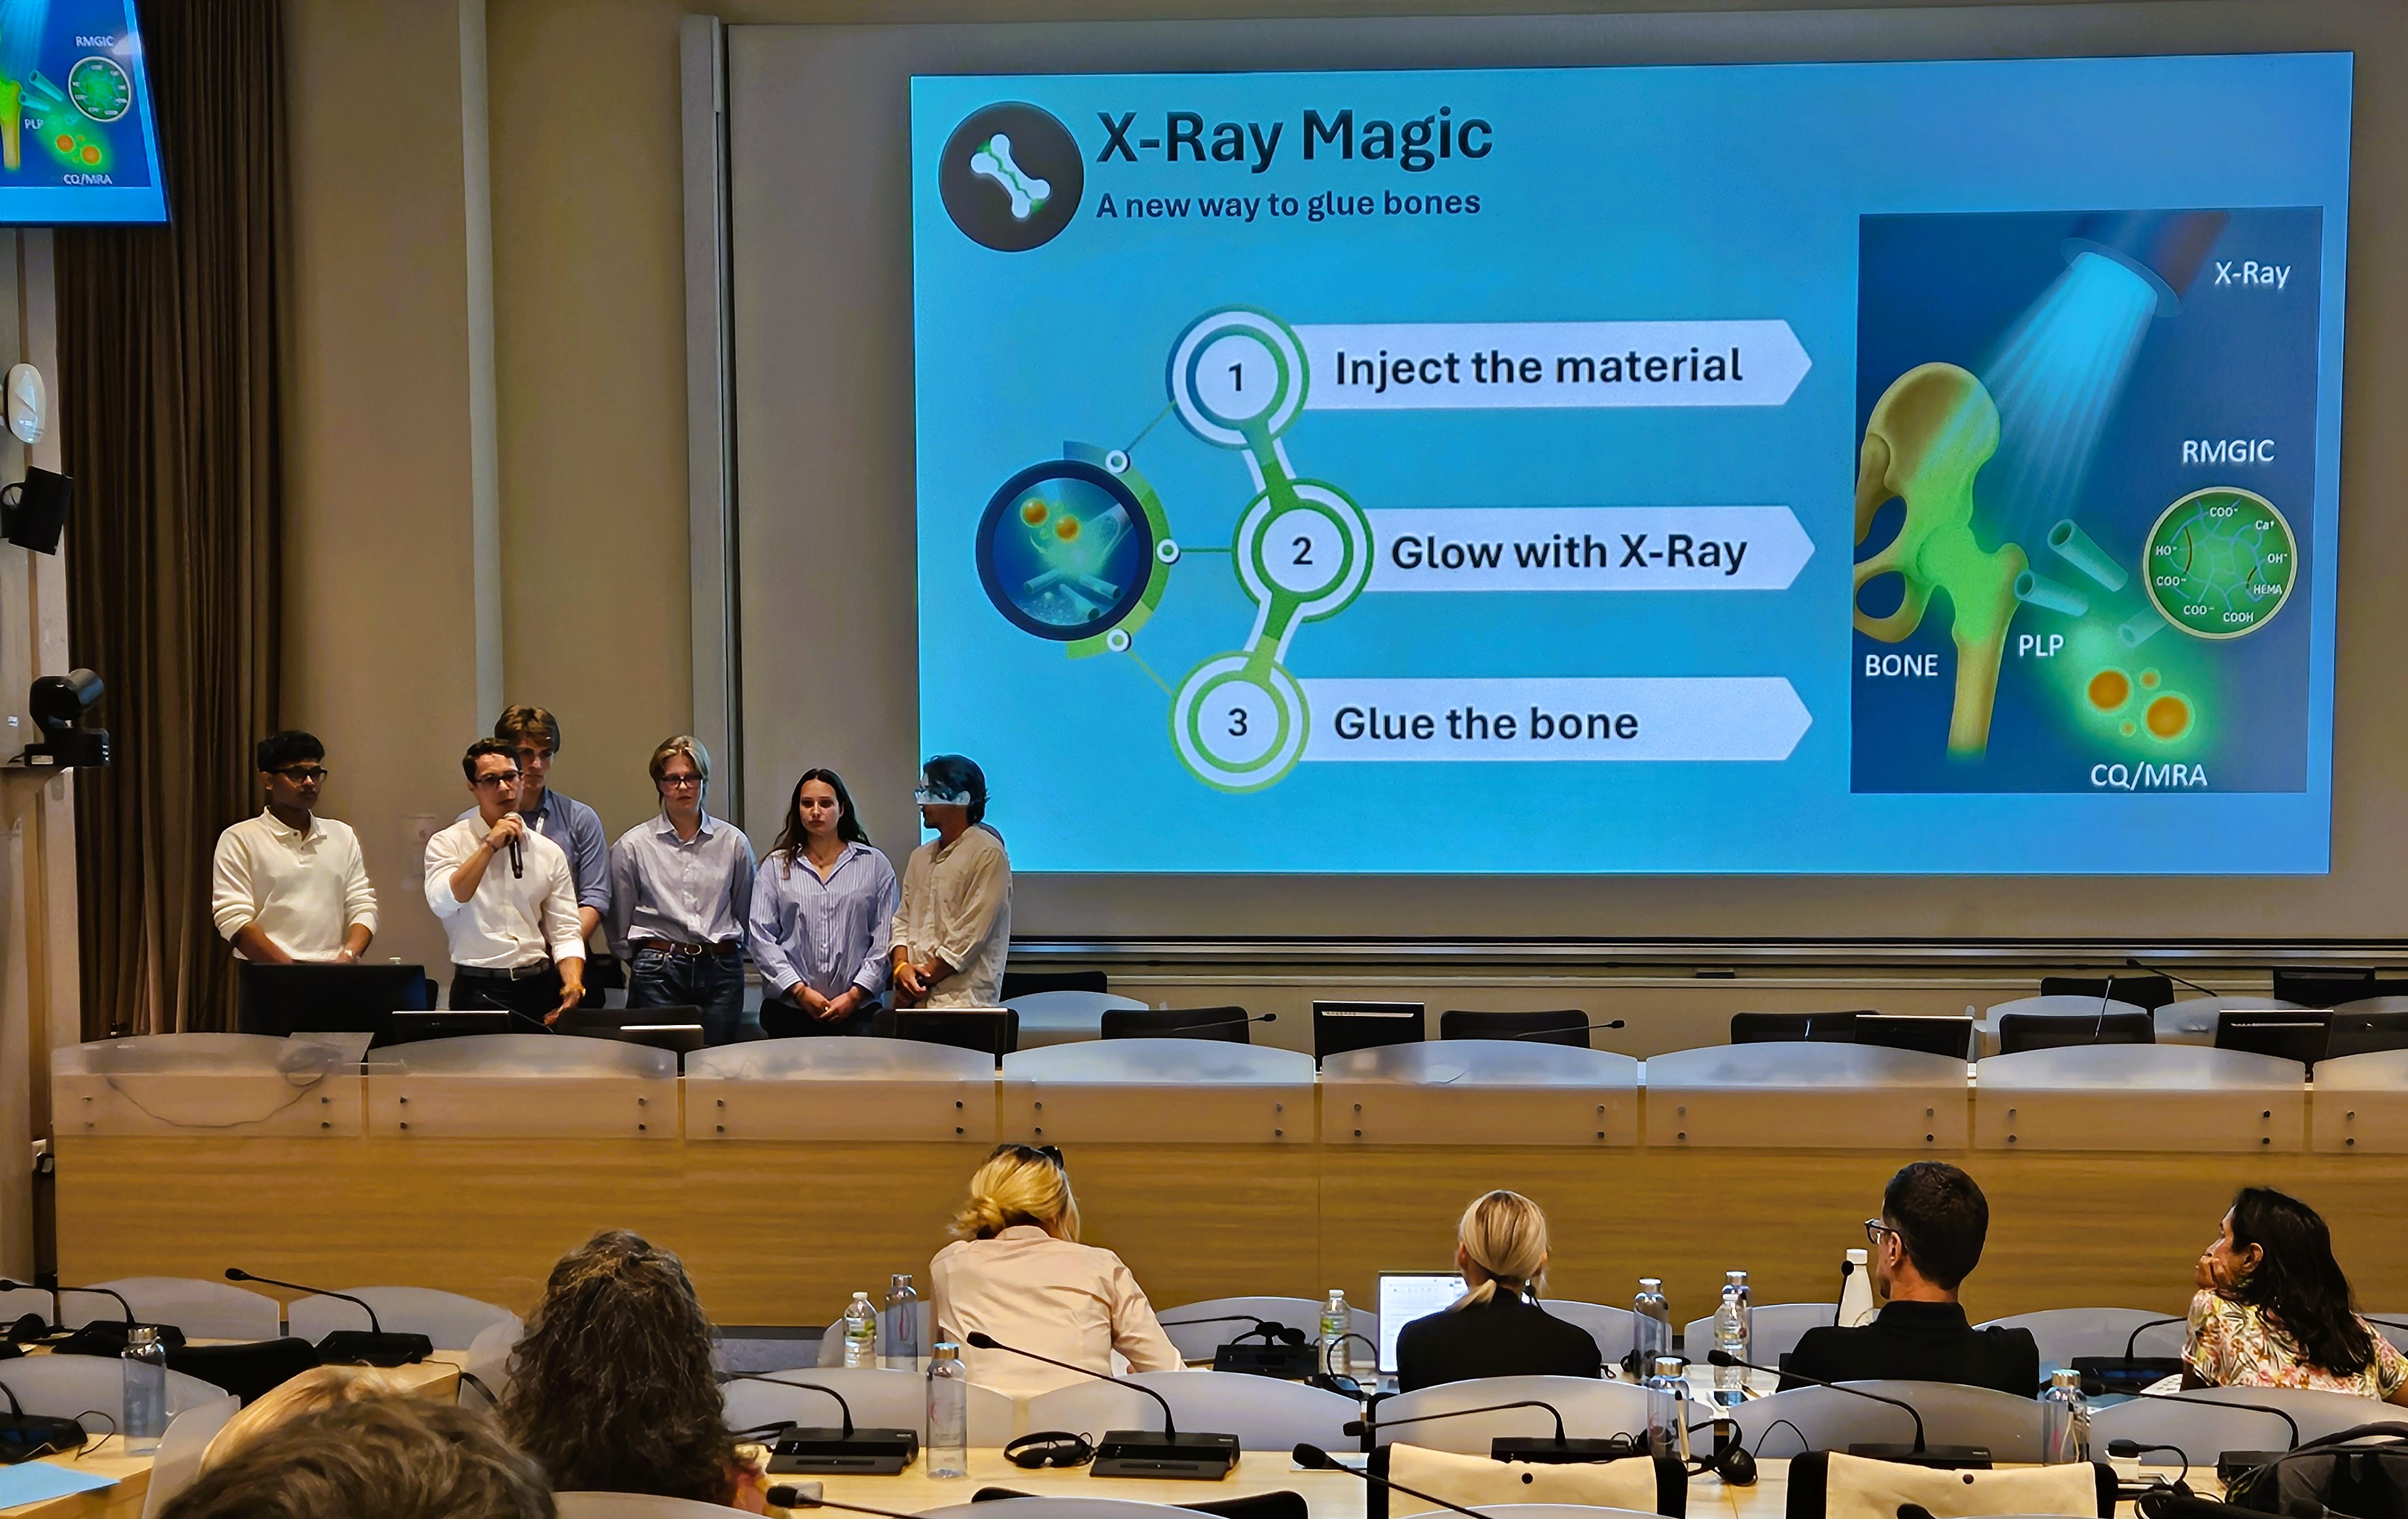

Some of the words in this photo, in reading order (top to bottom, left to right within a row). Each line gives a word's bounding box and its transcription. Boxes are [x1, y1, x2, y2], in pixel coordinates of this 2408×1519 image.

[76, 36, 115, 46] RMGIC
[25, 119, 44, 129] PLP
[1096, 111, 1283, 174] X-Ray
[1303, 106, 1493, 172] Magic
[63, 174, 113, 185] CQ/MRA
[1096, 193, 1119, 218] A
[1126, 197, 1190, 218] new
[1200, 198, 1259, 222] way
[1269, 193, 1299, 217] to
[1308, 192, 1374, 222] glue
[1384, 190, 1481, 215] bones
[2214, 261, 2291, 289] X-Ray
[1229, 363, 1243, 391] 1
[1336, 351, 1460, 393] Inject
[1471, 349, 1543, 383] the
[1556, 347, 1743, 382] material
[2183, 439, 2275, 463] RMGIC
[1292, 537, 1314, 566] 2
[1391, 535, 1504, 570] Glow
[1513, 534, 1608, 568] with
[1620, 534, 1748, 575] X-Ray
[2254, 585, 2282, 595] HEMA
[2224, 612, 2254, 623] COOH
[2019, 635, 2064, 657] PLP
[1865, 655, 1938, 677] BONE
[1227, 708, 1248, 737] 3
[1335, 706, 1435, 740] Glue
[1445, 705, 1517, 739] the
[1530, 705, 1639, 740] bone
[2091, 763, 2208, 790] CQ/MRA
